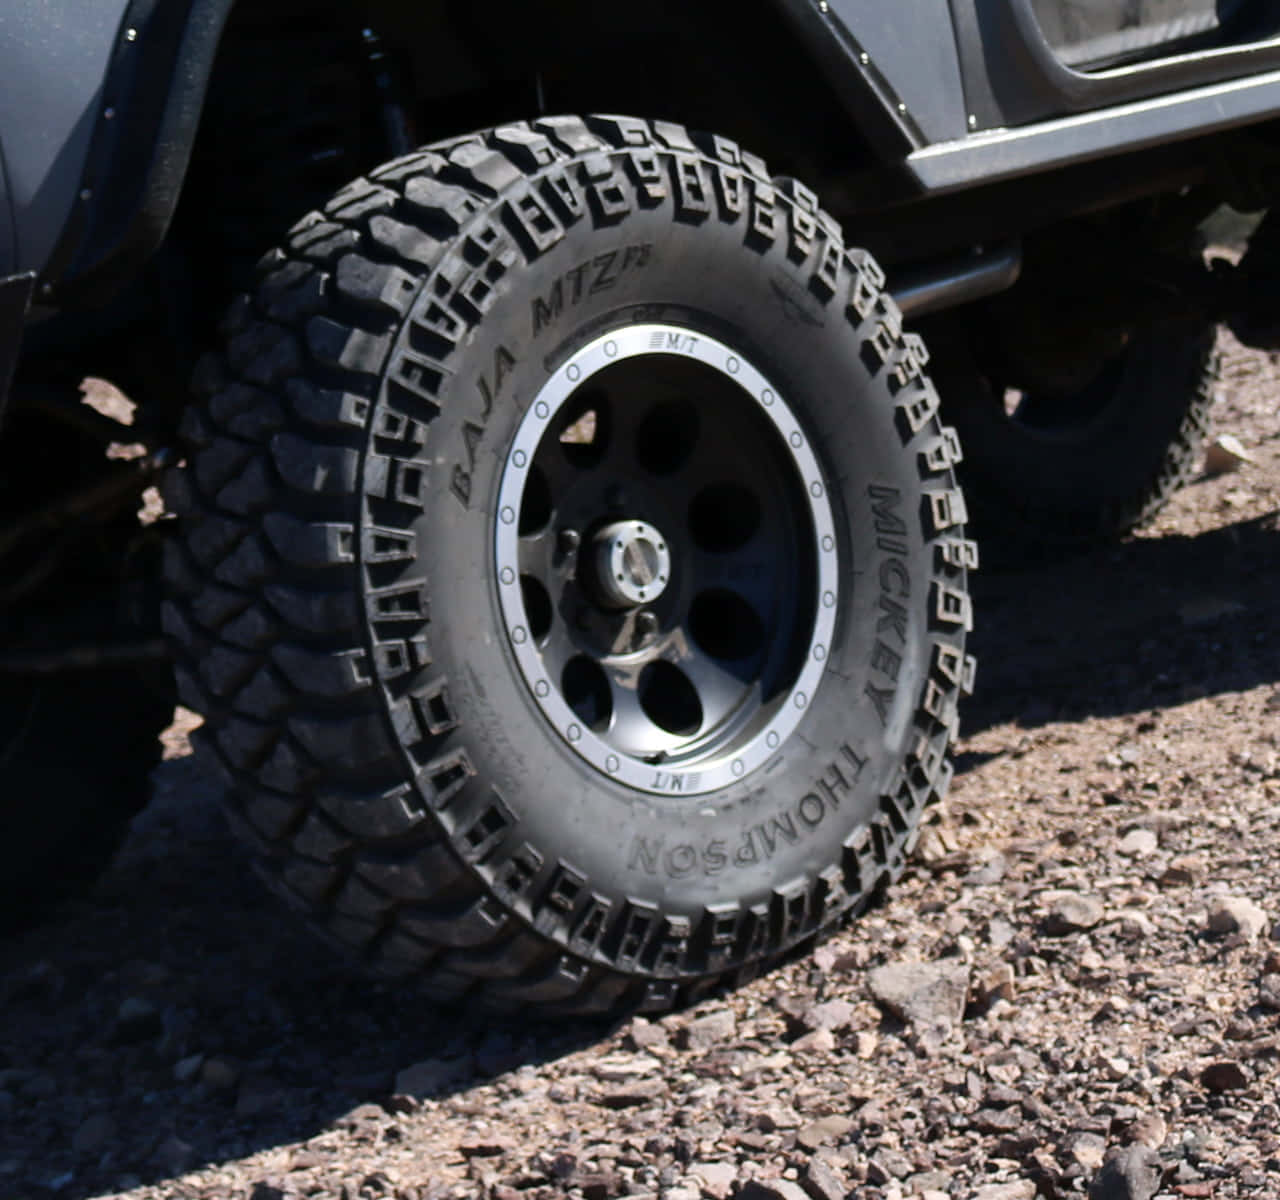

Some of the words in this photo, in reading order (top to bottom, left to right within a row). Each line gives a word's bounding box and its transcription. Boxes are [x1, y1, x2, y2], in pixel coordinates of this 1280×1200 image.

[665, 332, 699, 355] M/T
[449, 344, 516, 511] BAJA
[864, 484, 911, 728] MICKEY
[626, 743, 872, 879] THOMPSON
